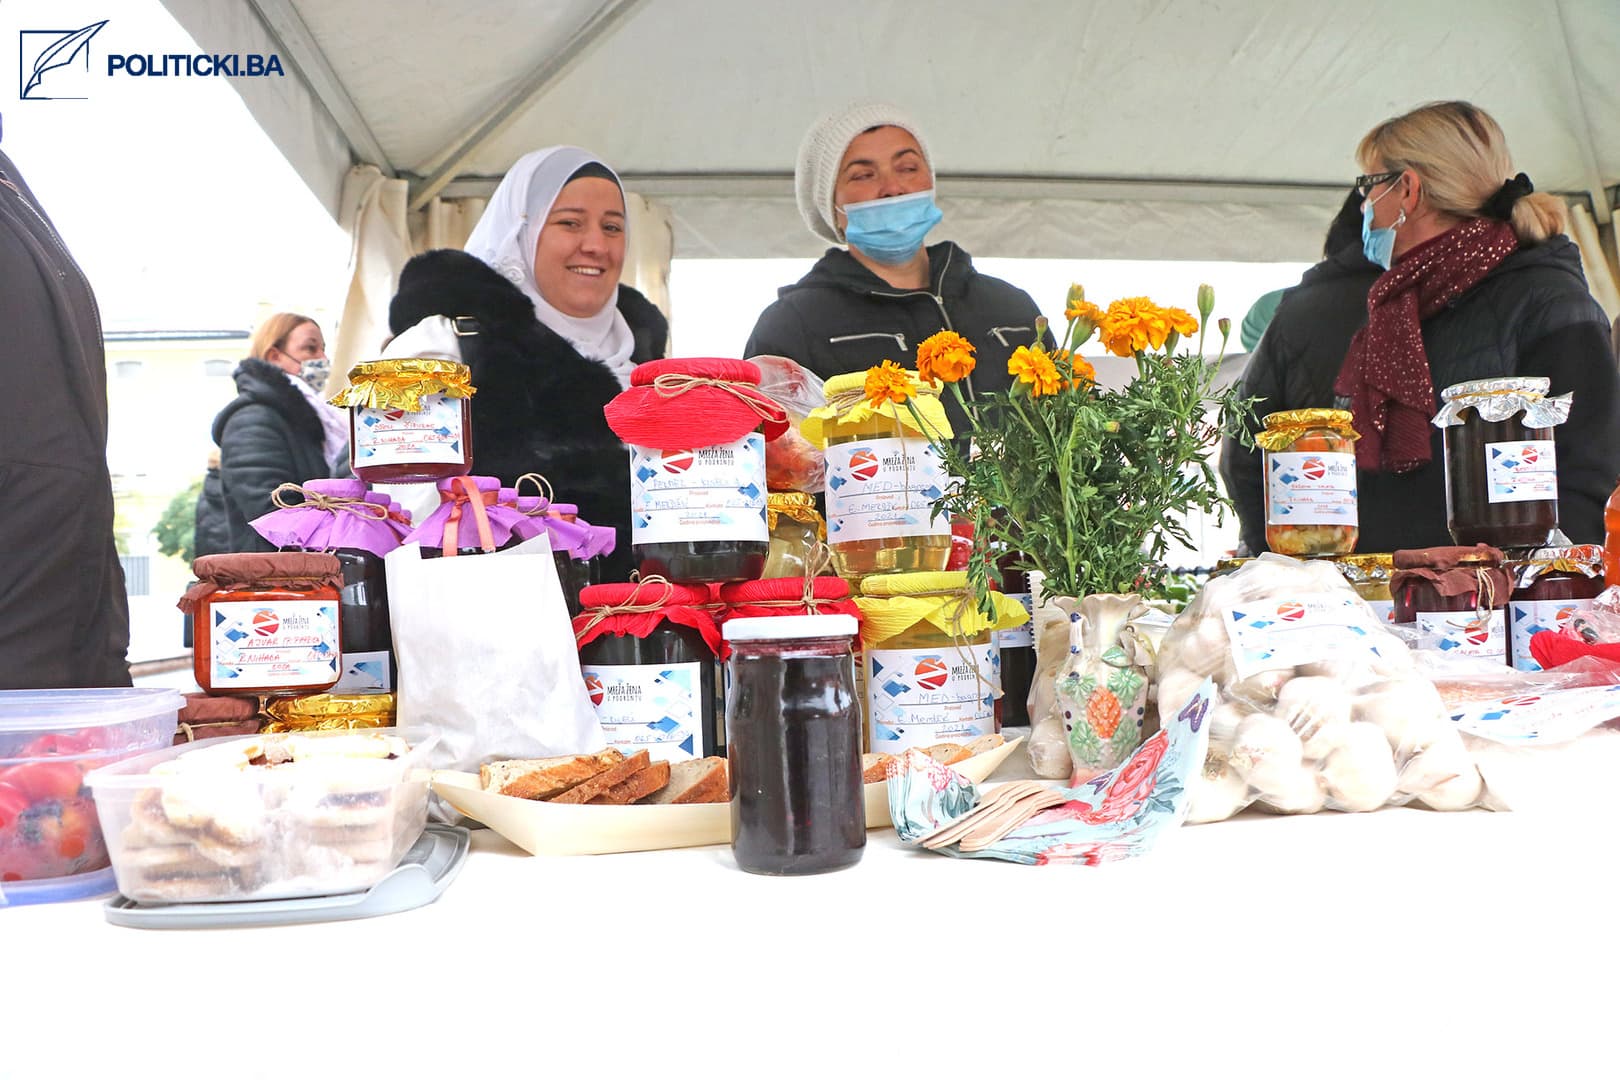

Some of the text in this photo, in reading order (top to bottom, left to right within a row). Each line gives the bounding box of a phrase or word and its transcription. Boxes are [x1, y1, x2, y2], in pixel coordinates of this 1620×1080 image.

[698, 447, 734, 459] MREŽA ŽENA
[882, 454, 901, 466] MREŽA
[951, 662, 968, 675] MREŽA
[607, 683, 642, 695] MREŽA ŽENA
